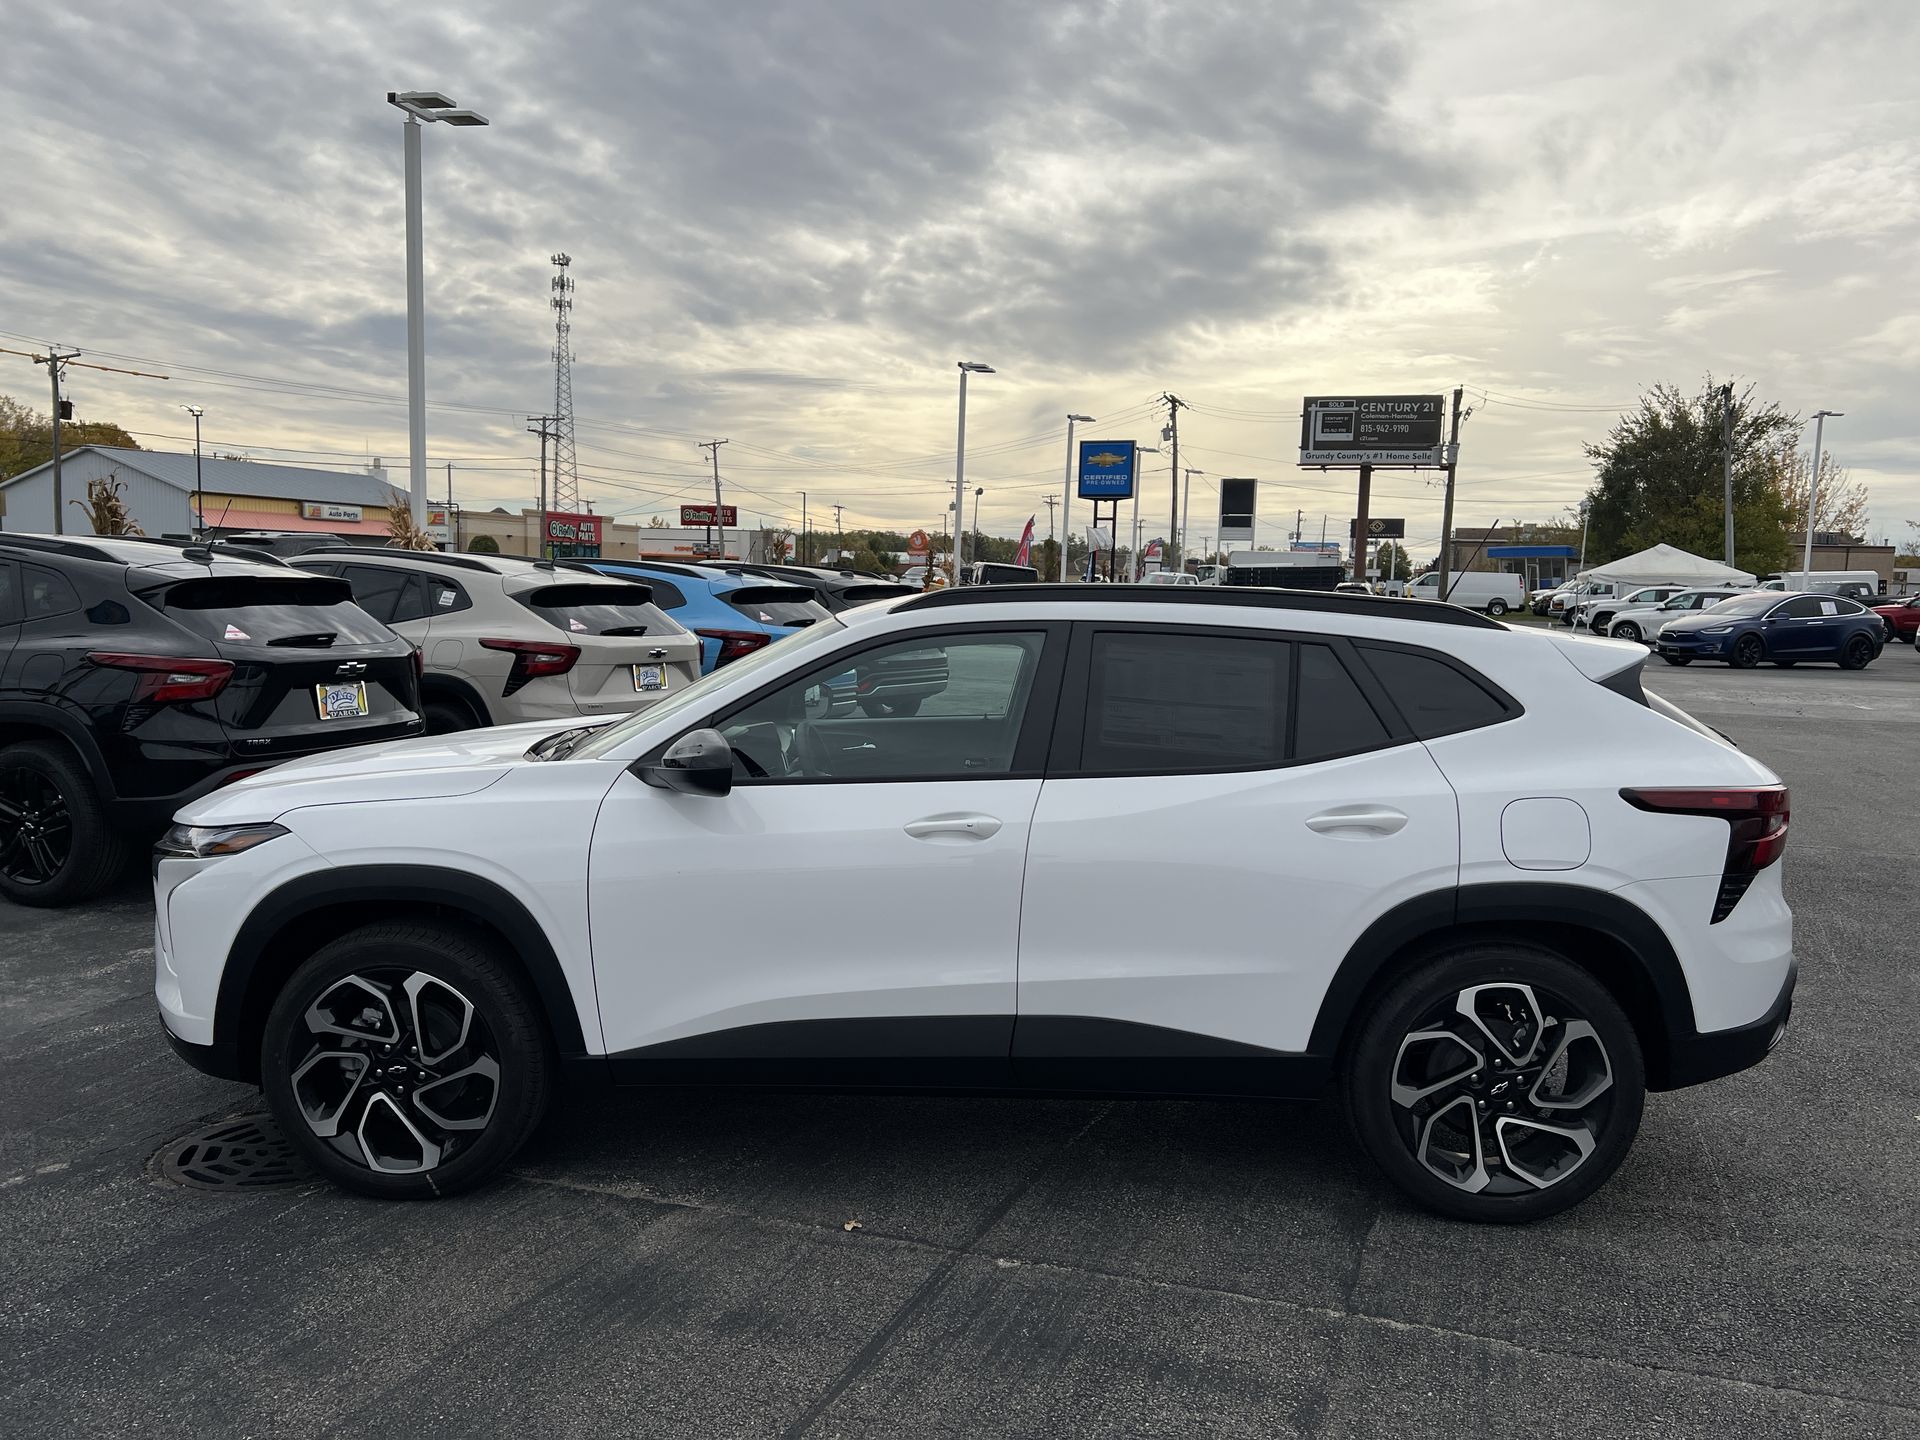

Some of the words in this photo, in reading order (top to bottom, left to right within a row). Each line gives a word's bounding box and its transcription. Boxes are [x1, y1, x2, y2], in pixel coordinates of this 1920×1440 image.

[1361, 402, 1420, 412] CENTURY
[1423, 402, 1434, 412] 21
[1360, 424, 1409, 433] 815-942-9190
[1305, 452, 1335, 460] Grundy
[1337, 452, 1370, 460] County's
[683, 509, 712, 523] O'Reilly
[550, 521, 576, 540] O'Reilly
[580, 522, 594, 532] AUTO
[578, 532, 595, 541] PARTS
